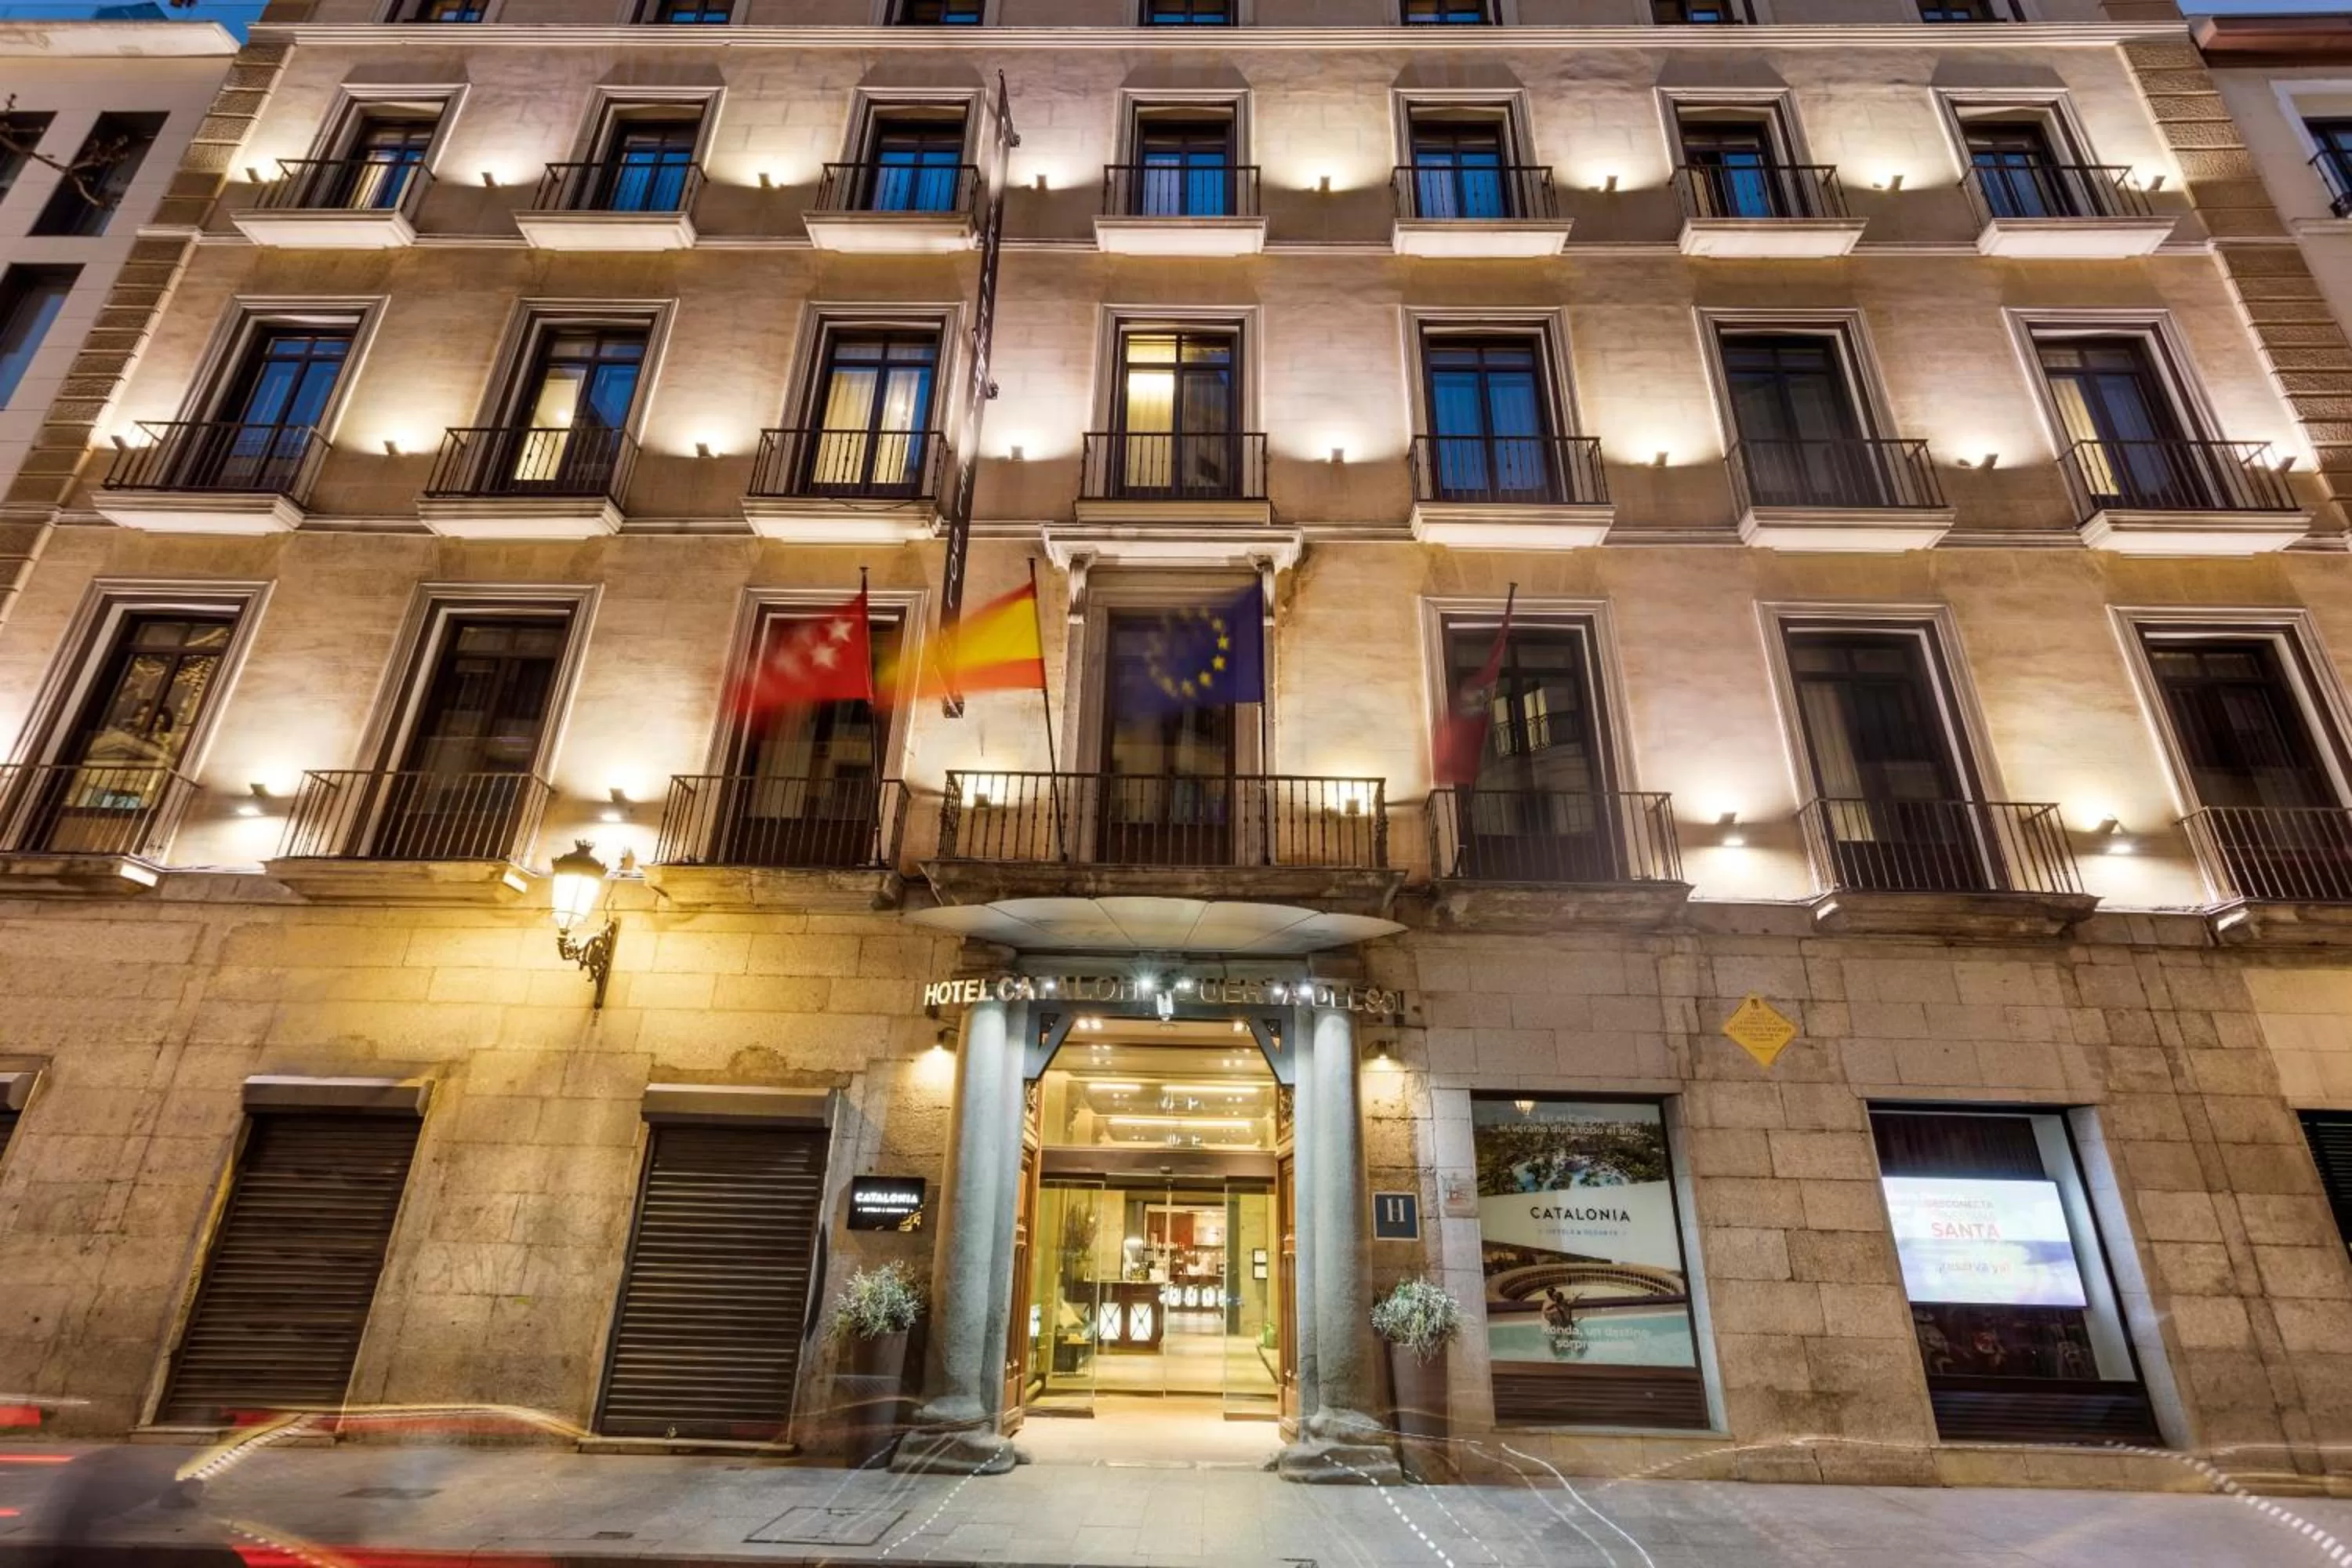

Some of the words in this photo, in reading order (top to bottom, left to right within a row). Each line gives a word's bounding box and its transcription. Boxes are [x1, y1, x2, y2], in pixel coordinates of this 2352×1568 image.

[924, 978, 994, 1007] HOTEL
[855, 1191, 919, 1204] CATALONIA
[1530, 1207, 1631, 1222] CATALONIA
[1931, 1221, 2000, 1240] SANTA
